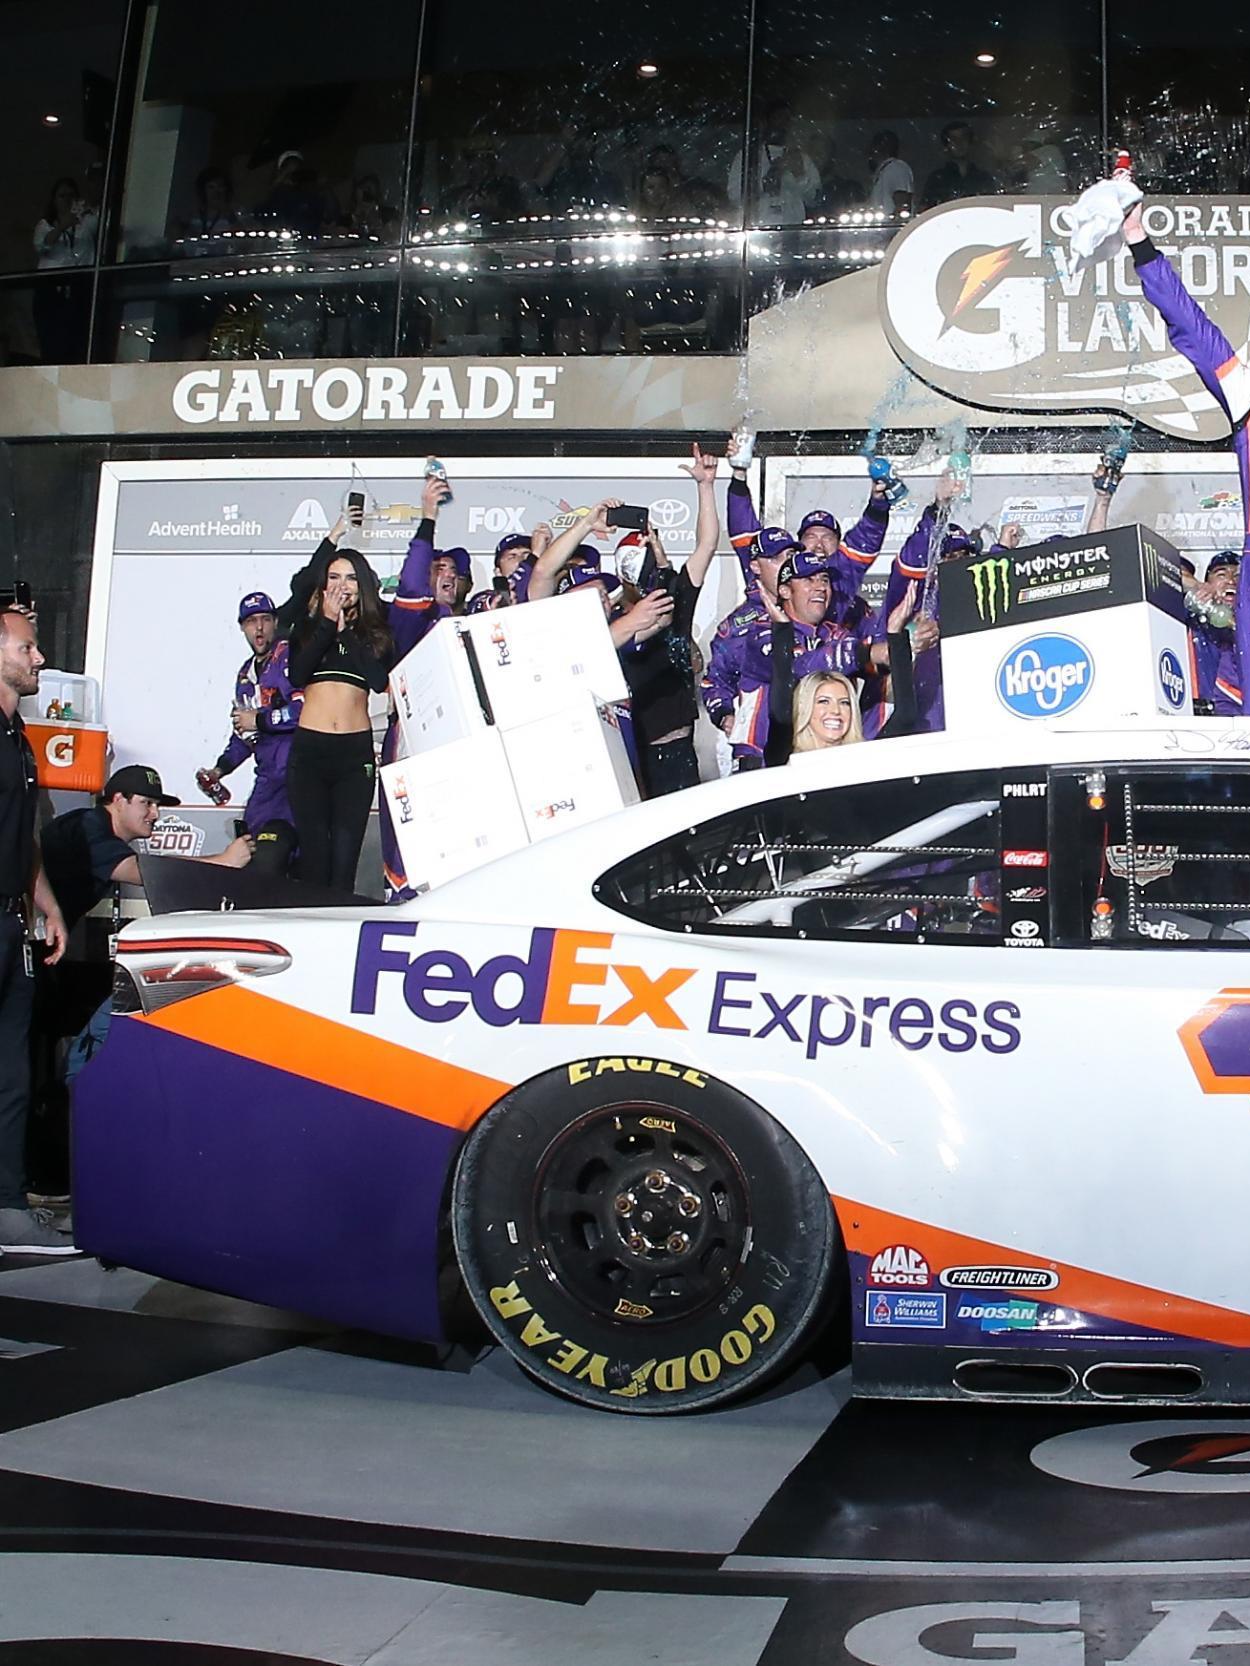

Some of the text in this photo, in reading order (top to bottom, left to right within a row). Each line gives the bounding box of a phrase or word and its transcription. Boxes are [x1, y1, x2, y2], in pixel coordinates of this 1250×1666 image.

[887, 204, 1046, 373] G
[1057, 301, 1167, 353] LAN
[172, 366, 557, 424] GATORADE
[467, 506, 526, 534] FOX
[1007, 511, 1078, 523] SPEEDWEEKS
[1155, 512, 1243, 531] DAYTON
[148, 520, 263, 537] AdventHealth
[362, 529, 417, 540] CHEVRO
[658, 530, 697, 542] YOTA
[1014, 545, 1111, 577] MONSTER
[1029, 566, 1096, 586] ENERGY
[490, 622, 512, 667] FedEx
[1004, 649, 1088, 711] Kroger
[1160, 655, 1184, 703] Kroger
[45, 734, 75, 768] G
[394, 774, 414, 825] FedEx
[1003, 783, 1047, 798] PHLRT
[534, 797, 577, 820] FedEx
[152, 824, 191, 833] DAYTONA
[150, 833, 193, 850] 500
[1004, 937, 1045, 948] TOYOTA
[351, 921, 698, 1031] FedEx
[707, 971, 1022, 1061] Express
[870, 1246, 929, 1274] MAC
[870, 1272, 929, 1285] TOOLS
[950, 1271, 1048, 1285] FREIGHTLINER
[619, 1302, 648, 1316] AERO
[894, 1306, 938, 1317] WILLIAMS
[897, 1299, 938, 1308] SHERWIN
[957, 1305, 1036, 1321] DOOSAN
[489, 1279, 776, 1395] GOODYEAR
